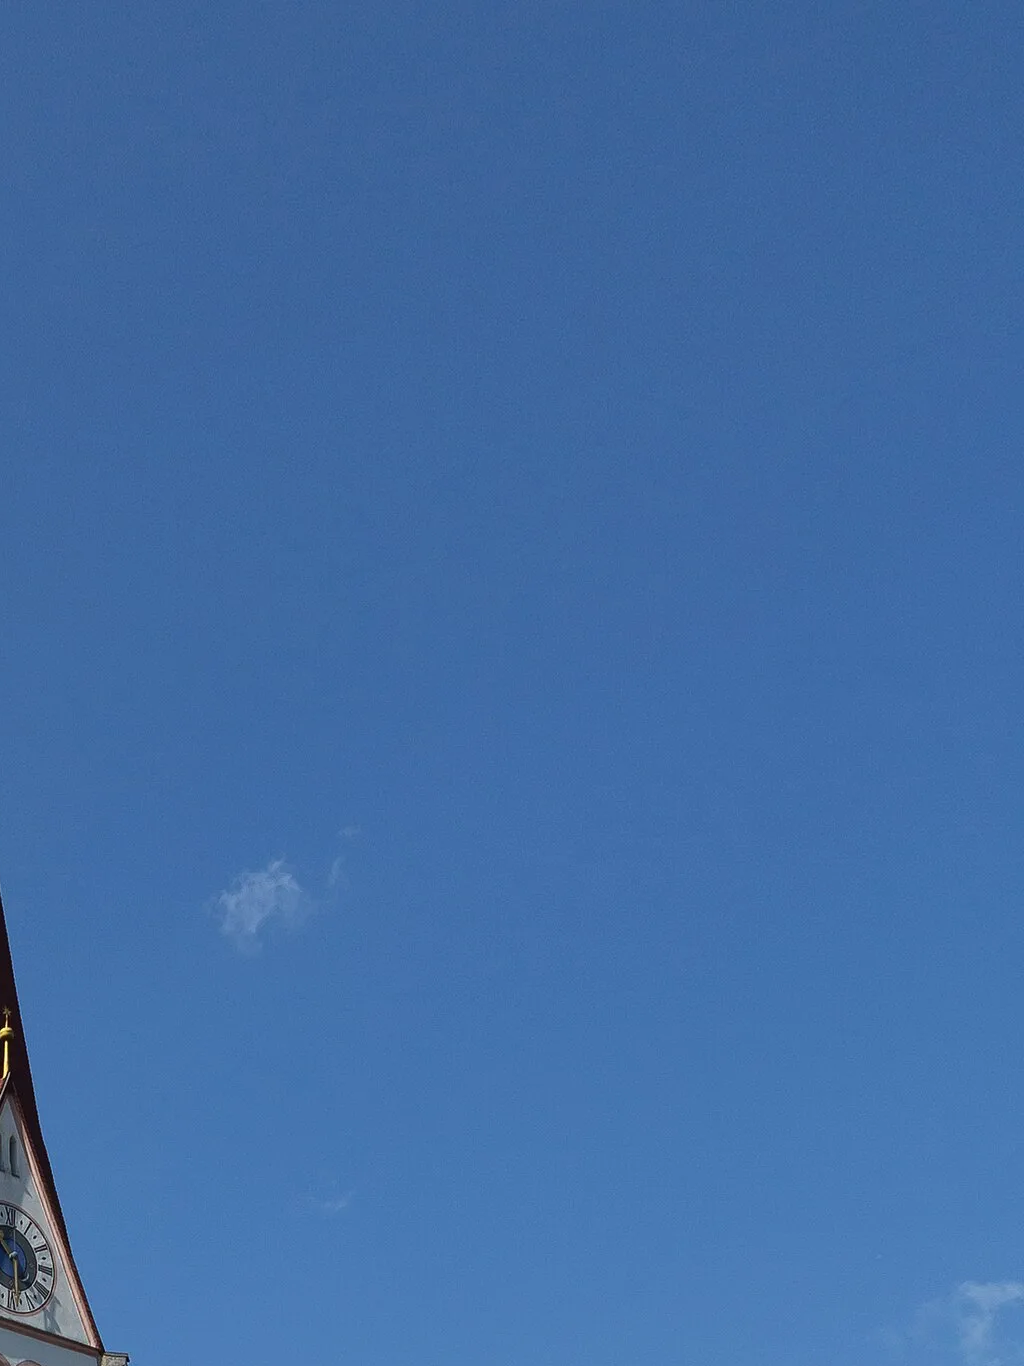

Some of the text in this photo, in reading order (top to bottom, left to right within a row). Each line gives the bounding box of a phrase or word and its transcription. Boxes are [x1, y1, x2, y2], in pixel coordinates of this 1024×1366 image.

[5, 1206, 16, 1226] XII
[24, 1221, 33, 1236] I
[33, 1244, 48, 1254] II
[38, 1264, 53, 1277] III
[24, 1291, 35, 1311] V
